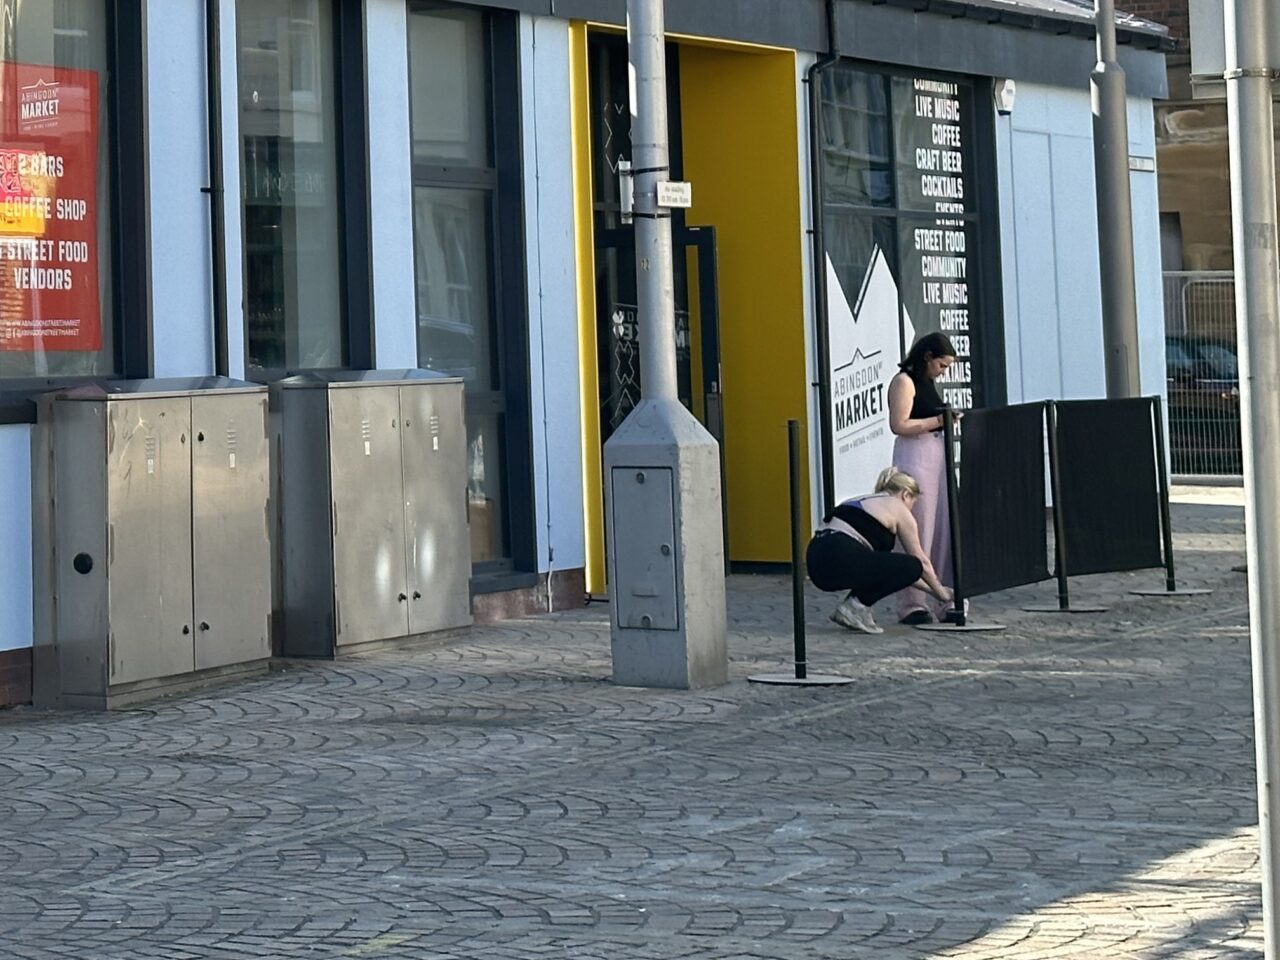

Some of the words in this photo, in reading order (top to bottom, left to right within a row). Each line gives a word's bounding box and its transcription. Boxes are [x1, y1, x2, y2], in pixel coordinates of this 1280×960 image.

[21, 99, 59, 120] MARKET
[915, 95, 933, 118] LIVE
[934, 97, 960, 122] MUSIC
[931, 123, 962, 147] COFFEE
[31, 153, 64, 177] BARS
[916, 147, 940, 171] CRAFT
[942, 150, 962, 173] BEER
[921, 174, 963, 199] COCKTAILS
[4, 195, 52, 219] COFFEE
[56, 198, 87, 221] SHOP
[6, 239, 54, 262] STREET
[58, 240, 88, 263] FOOD
[914, 228, 943, 251] STREET
[945, 230, 966, 253] FOOD
[13, 267, 72, 290] VENDORS
[921, 255, 967, 278] COMMUNITY
[922, 282, 941, 305] LIVE
[942, 283, 968, 305] MUSIC
[940, 308, 969, 331] COFFEE
[834, 364, 880, 399] ABINGDON
[835, 383, 883, 432] MARKET
[943, 387, 973, 409] EVENTS
